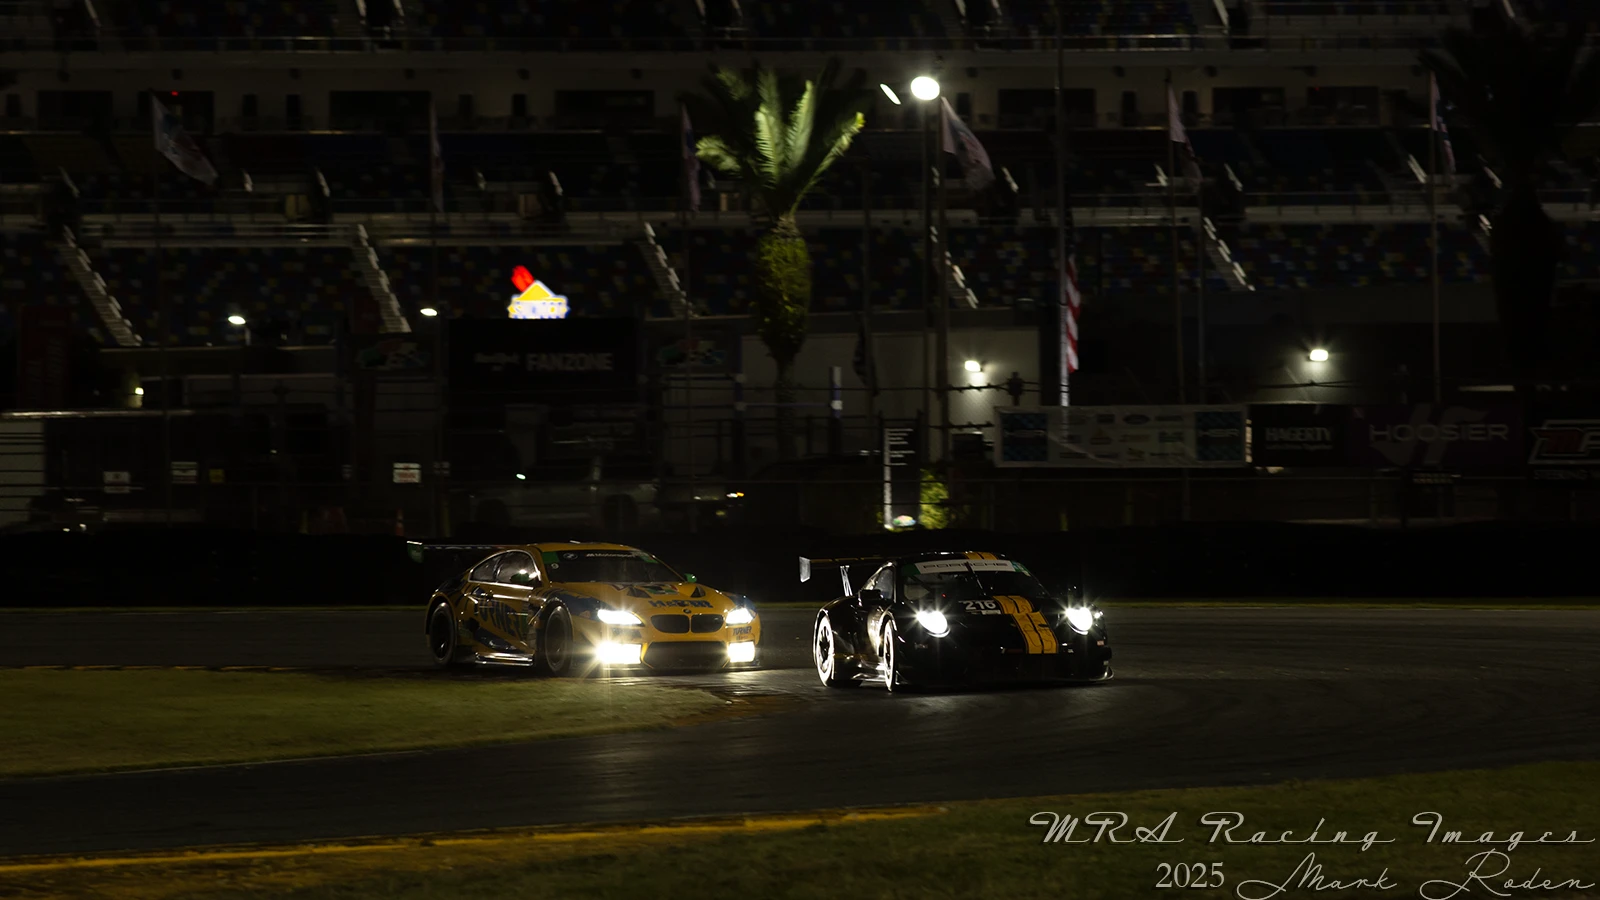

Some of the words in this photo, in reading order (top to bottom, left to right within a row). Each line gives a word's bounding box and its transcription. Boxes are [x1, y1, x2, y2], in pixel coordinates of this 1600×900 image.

[525, 352, 614, 372] FANZONE
[1264, 427, 1335, 442] HAGERTY
[1369, 424, 1510, 442] HOOSIER
[963, 599, 997, 611] 216
